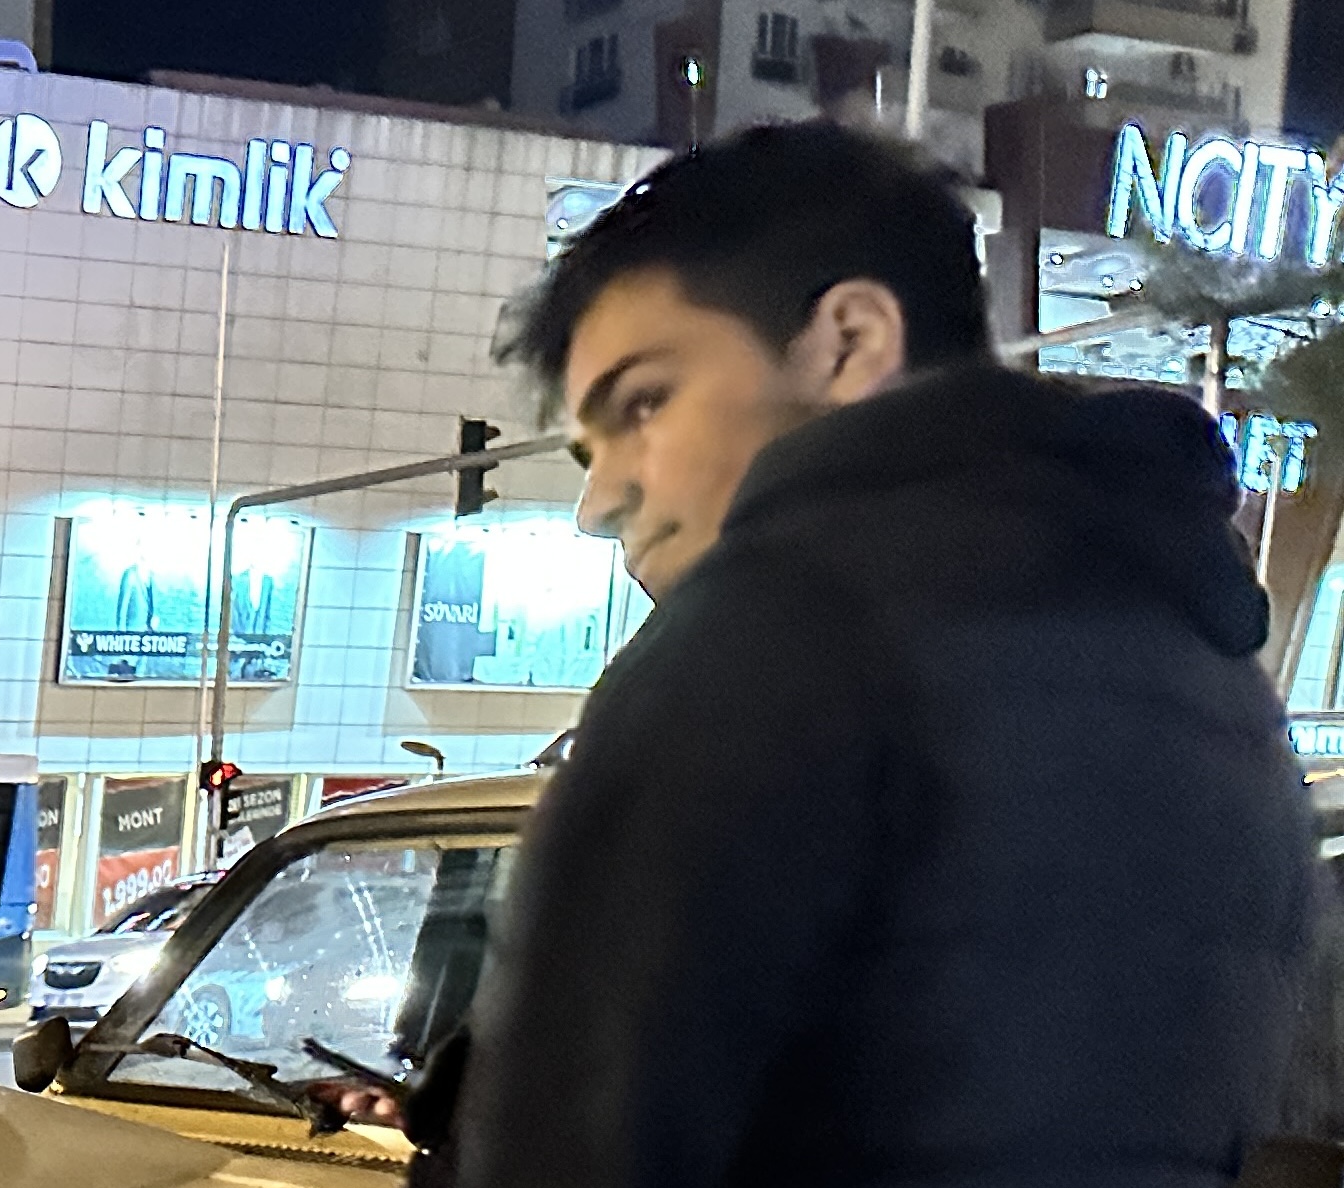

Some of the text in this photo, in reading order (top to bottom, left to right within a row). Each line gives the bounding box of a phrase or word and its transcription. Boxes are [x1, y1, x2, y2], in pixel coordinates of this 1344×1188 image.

[82, 119, 352, 239] kimlik
[96, 634, 141, 652] WHITE
[142, 634, 187, 652] STONE
[117, 807, 164, 832] MONT
